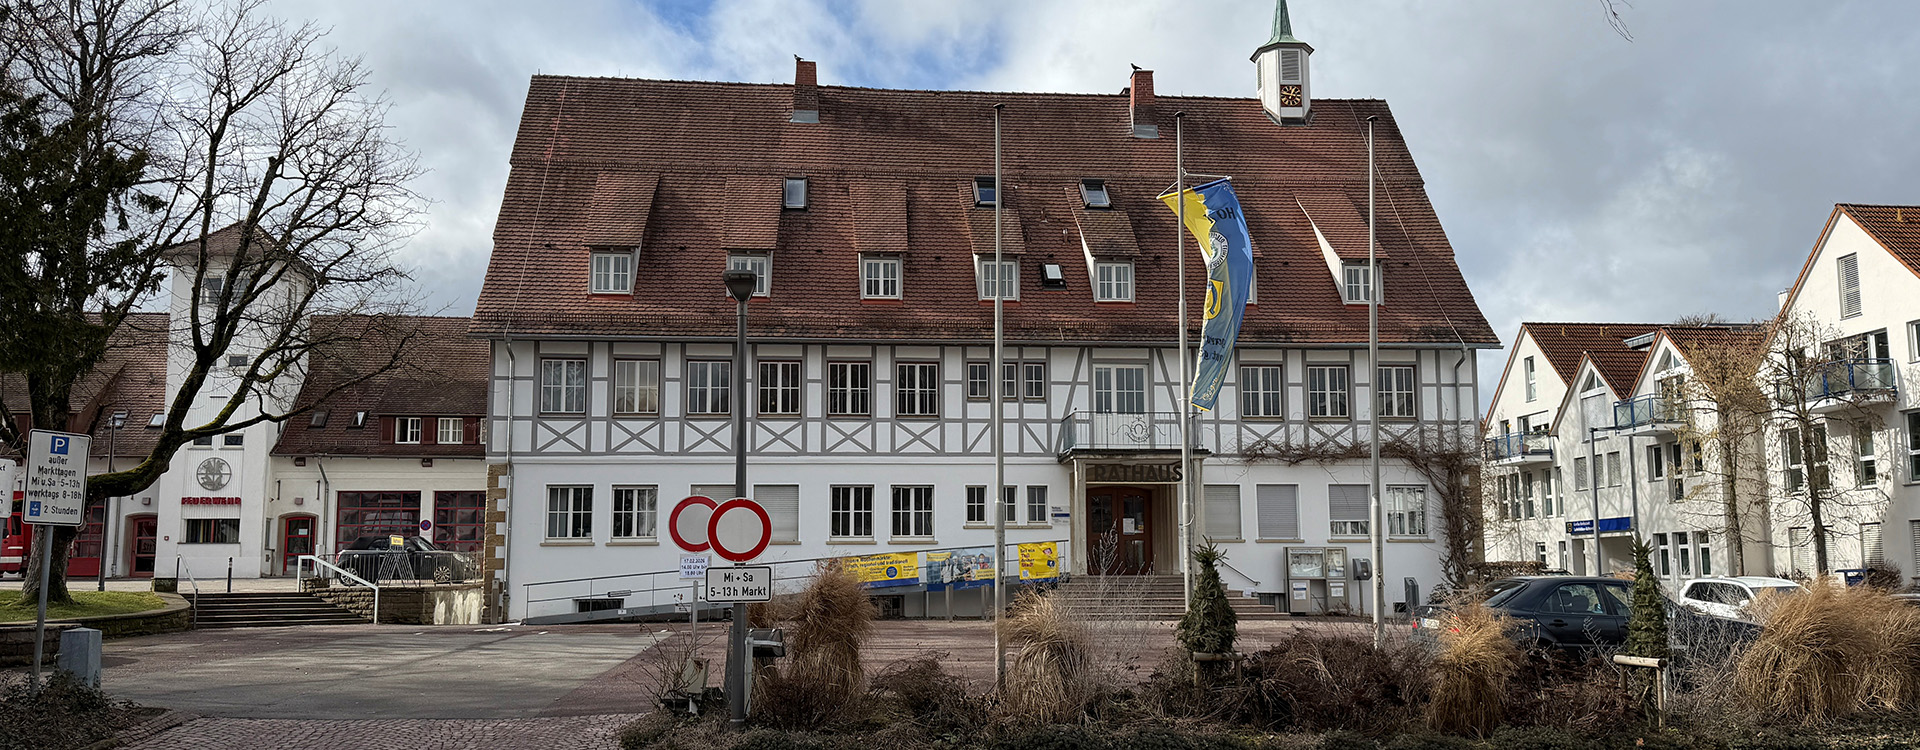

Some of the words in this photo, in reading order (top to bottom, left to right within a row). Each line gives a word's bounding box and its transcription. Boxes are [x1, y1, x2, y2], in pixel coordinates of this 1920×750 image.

[54, 438, 65, 452] P
[48, 456, 68, 465] außer
[37, 465, 77, 478] Markttagen
[1094, 464, 1183, 482] RATHAUS
[60, 480, 80, 488] 5-13h
[28, 489, 59, 500] werktags
[62, 490, 81, 500] 8-18h
[181, 496, 242, 505] FEUERWEHR
[43, 505, 48, 514] 2
[51, 505, 78, 515] Stunden
[723, 572, 734, 582] Mi
[742, 572, 753, 582] Sa
[741, 586, 766, 596] Markt
